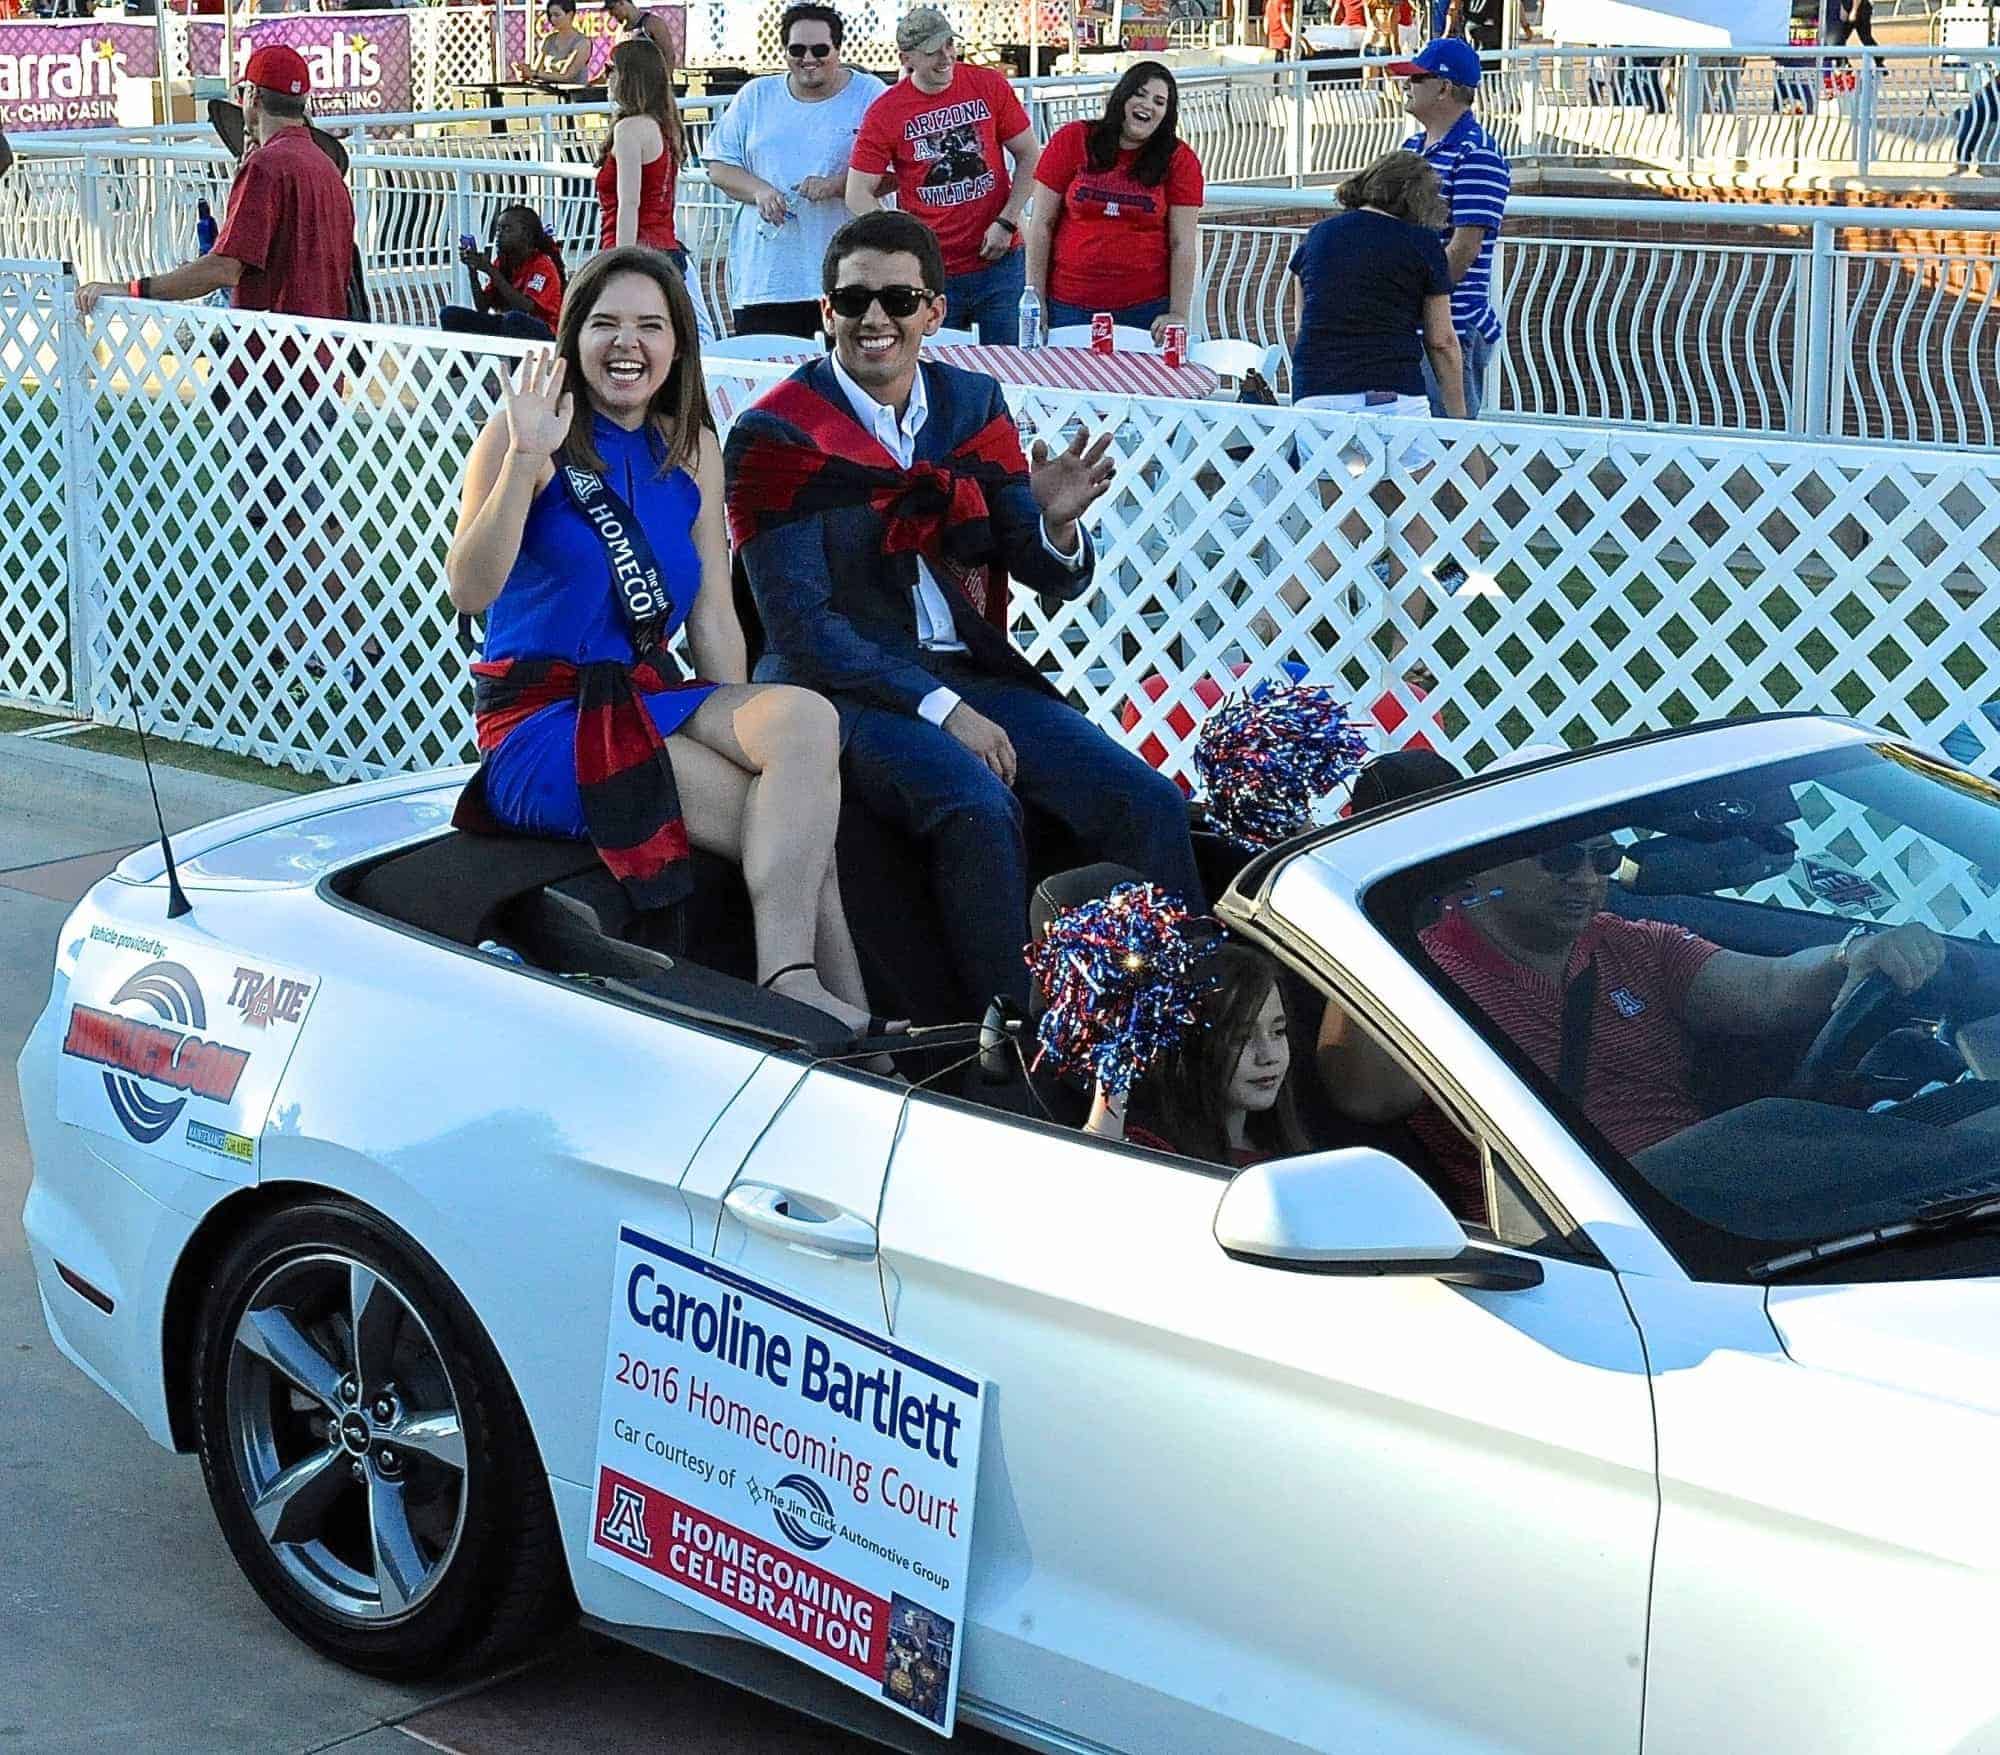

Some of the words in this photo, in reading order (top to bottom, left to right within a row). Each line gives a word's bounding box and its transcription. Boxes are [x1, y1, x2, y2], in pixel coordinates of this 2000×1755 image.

[903, 98, 992, 140] ARIZONA
[565, 466, 604, 503] A
[115, 934, 155, 953] provided
[227, 966, 311, 1023] TRADE
[253, 1000, 269, 1016] UP
[1609, 986, 1646, 1018] A
[627, 1263, 792, 1387] Caroline
[801, 1334, 961, 1468] Bartlett
[614, 1418, 641, 1445] Car
[645, 1432, 715, 1483] Courtesy
[718, 1468, 737, 1488] of
[615, 1353, 679, 1404] 2016
[688, 1375, 872, 1503] Homecoming
[881, 1467, 959, 1538] Court
[600, 1484, 651, 1559] A
[763, 1487, 784, 1508] The
[787, 1499, 807, 1519] Jim
[810, 1511, 837, 1533] Click
[839, 1526, 910, 1570] Automotive
[913, 1561, 950, 1591] Group
[669, 1545, 871, 1663] CELEBRATION
[672, 1511, 872, 1631] HOMECOMING
